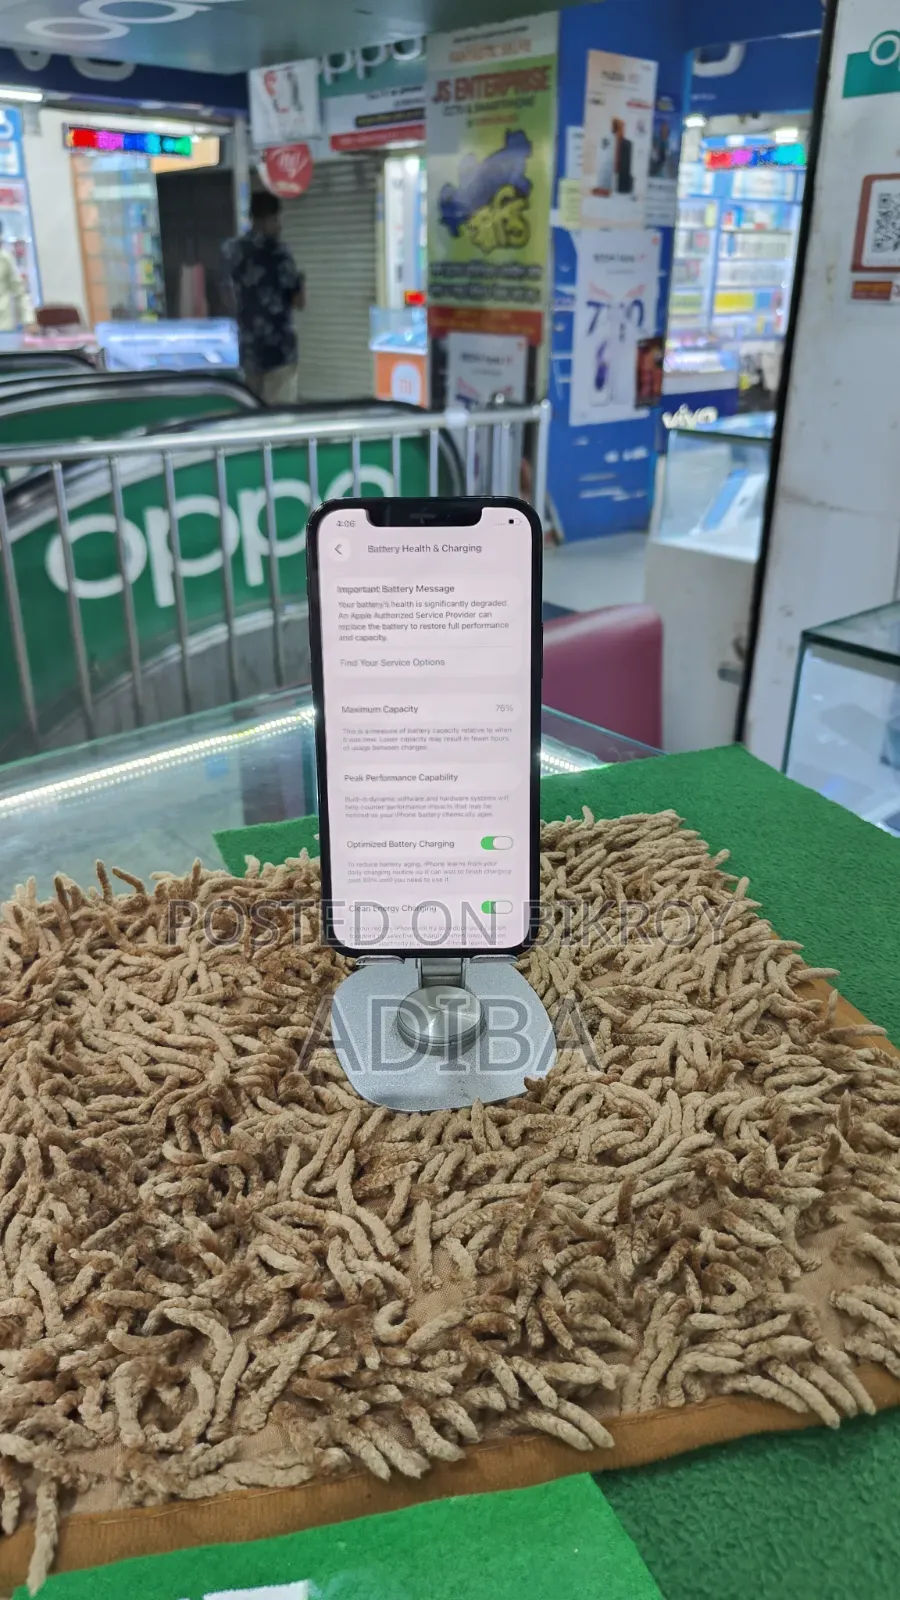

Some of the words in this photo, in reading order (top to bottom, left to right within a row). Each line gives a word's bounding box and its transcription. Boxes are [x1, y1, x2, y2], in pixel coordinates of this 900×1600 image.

[454, 64, 553, 103] ENTERPRISE
[662, 404, 718, 430] vivo
[336, 520, 356, 528] 4:06
[367, 545, 401, 555] Battery
[402, 544, 431, 553] Health
[433, 544, 440, 552] &
[441, 544, 483, 555] Charging
[337, 585, 380, 594] Important
[382, 585, 414, 594] Battery
[416, 584, 455, 594] Message
[338, 600, 355, 609] Your
[391, 600, 415, 609] health
[416, 600, 423, 609] is
[424, 600, 469, 609] significantly
[338, 612, 349, 620] An
[350, 611, 371, 620] Apple
[373, 611, 414, 620] Authorized
[367, 623, 381, 631] the
[382, 622, 409, 631] battery
[410, 622, 418, 631] to
[420, 622, 446, 631] restore
[448, 622, 460, 630] full
[461, 622, 509, 630] performance
[340, 659, 358, 667] Find
[360, 659, 379, 667] Your
[380, 659, 411, 667] Service
[413, 659, 445, 667] Options
[342, 705, 382, 714] Maximum
[383, 705, 419, 714] Capacity
[344, 774, 363, 782] Peak
[365, 774, 417, 782] Performance
[419, 774, 459, 782] Capability
[347, 841, 387, 849] Optimized
[389, 840, 416, 849] Battery
[418, 840, 455, 849] Charging
[348, 904, 370, 914] Clean
[372, 904, 400, 914] Energy
[401, 904, 438, 914] Charging
